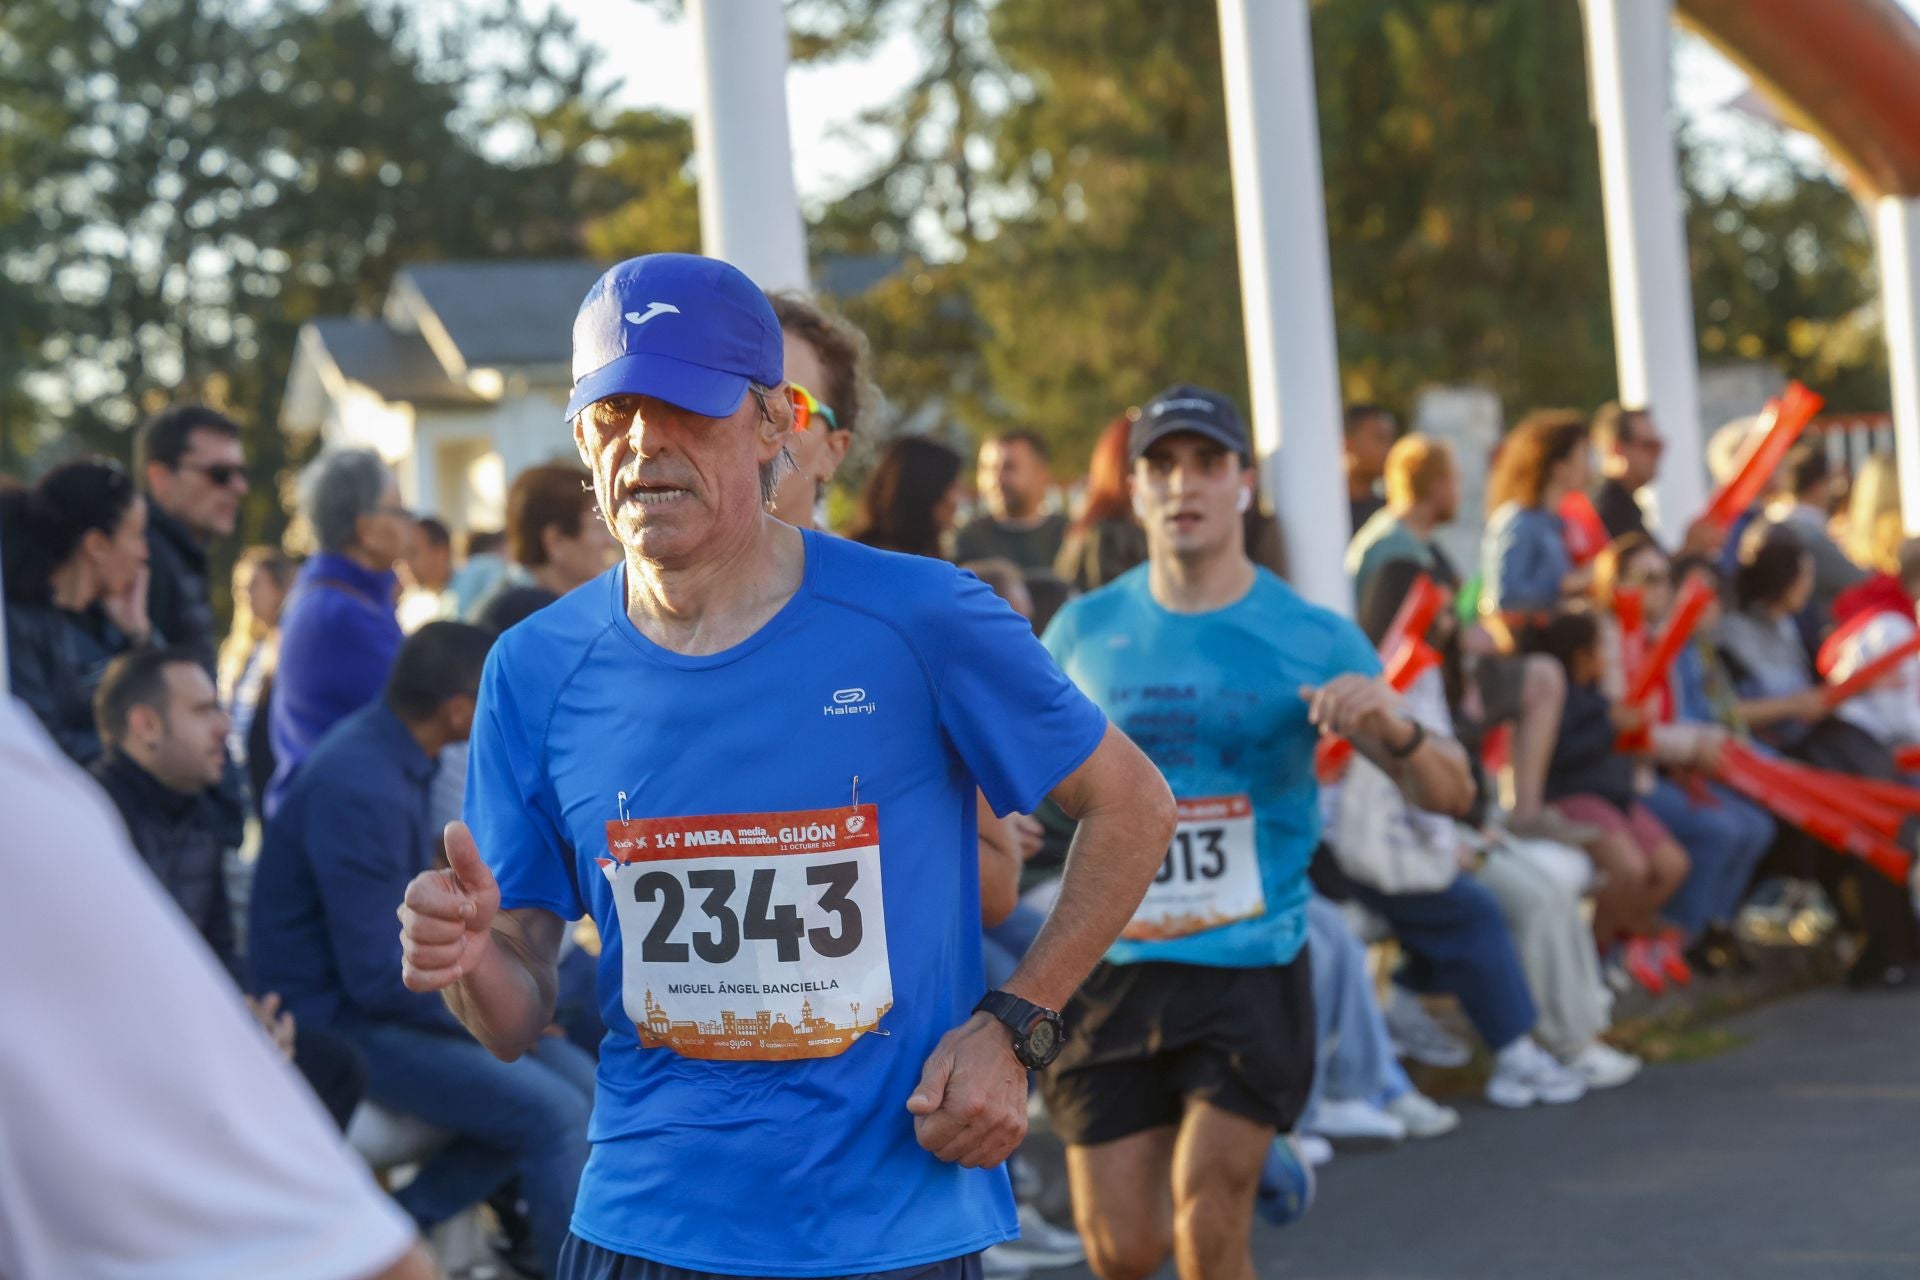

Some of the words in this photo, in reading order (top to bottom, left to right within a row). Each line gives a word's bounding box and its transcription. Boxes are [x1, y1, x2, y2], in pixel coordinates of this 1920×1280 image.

[824, 701, 876, 716] Kalenji
[738, 826, 767, 836] media
[779, 822, 836, 843] GIJÓN
[655, 832, 680, 849] 14ª
[684, 829, 736, 847] MBA
[739, 834, 778, 845] maratón
[790, 842, 820, 850] OCTUBRE
[821, 840, 836, 848] 2025
[634, 861, 863, 963] 2343
[668, 983, 715, 994] MIGUEL
[718, 981, 760, 994] ÁNGEL
[762, 979, 839, 994] BANCIELLA
[807, 1037, 843, 1046] SIROKO
